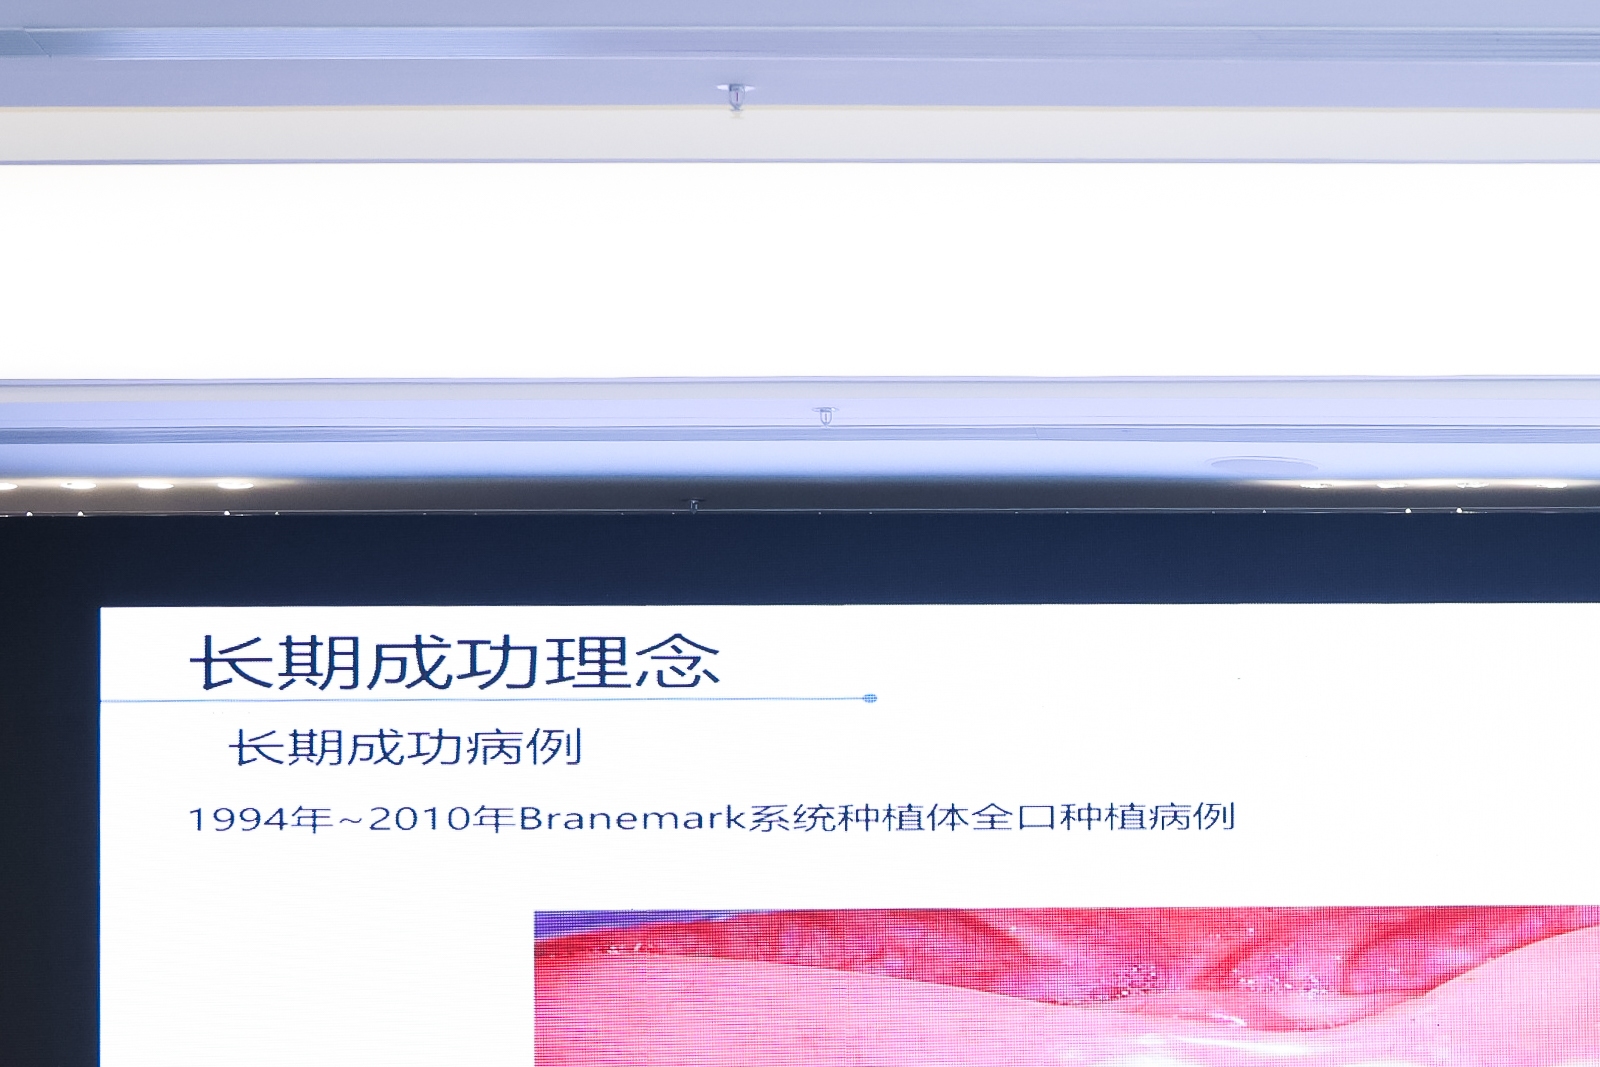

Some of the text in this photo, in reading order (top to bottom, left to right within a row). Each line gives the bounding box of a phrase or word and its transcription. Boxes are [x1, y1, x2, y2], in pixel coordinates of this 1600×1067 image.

[189, 633, 720, 691] 长期成功理念
[229, 728, 582, 767] 长期成功病例
